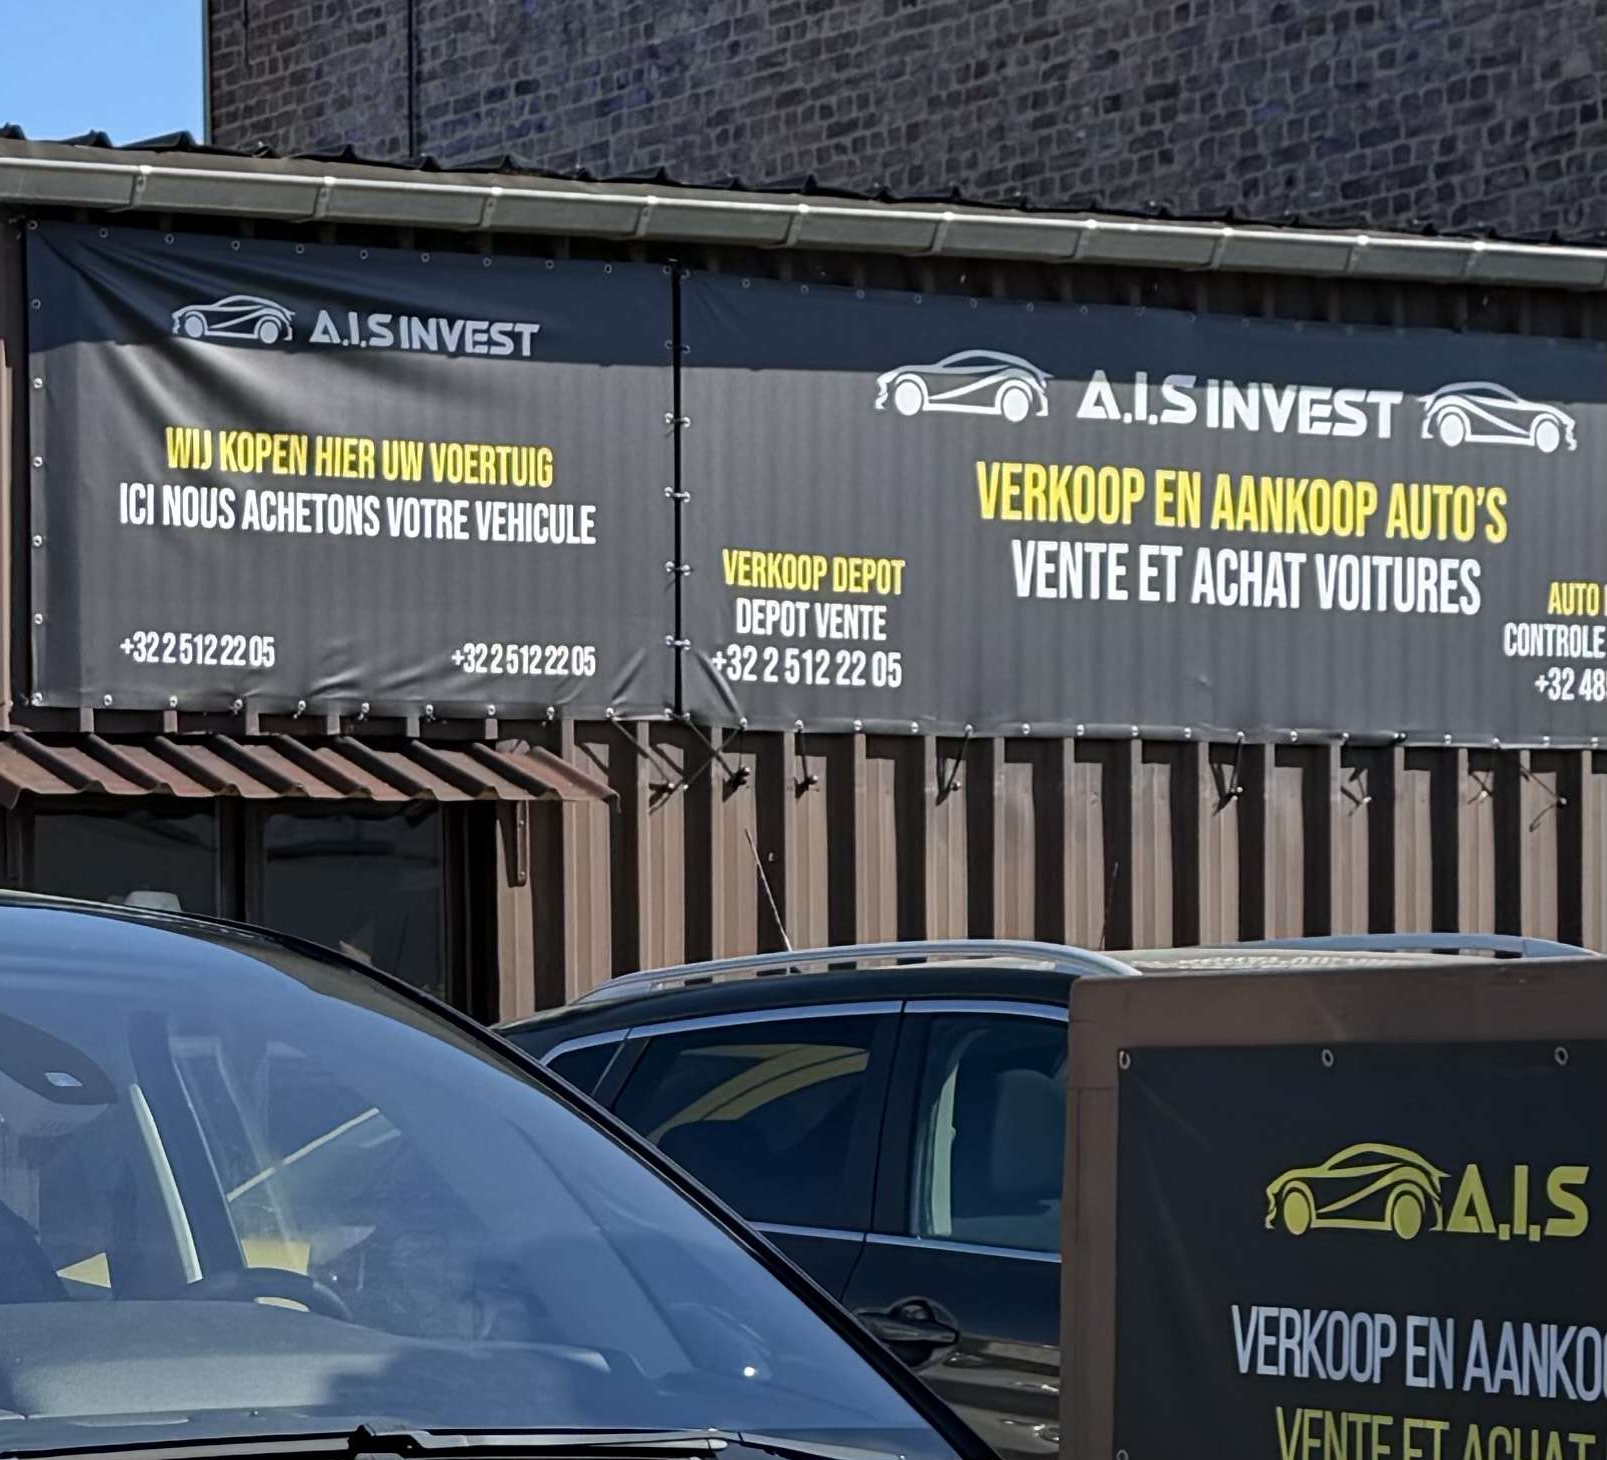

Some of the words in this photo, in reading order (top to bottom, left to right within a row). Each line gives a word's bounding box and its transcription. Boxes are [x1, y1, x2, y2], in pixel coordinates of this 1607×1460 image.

[309, 309, 393, 348] A.I.S
[400, 315, 541, 359] INVEST
[1075, 369, 1198, 426] A.I.S
[1205, 378, 1405, 440] INVEST
[165, 426, 213, 471] WIJ
[218, 430, 309, 477] KOPEN
[314, 435, 376, 480] HIER
[381, 439, 425, 483] UW
[430, 441, 554, 489] VOERTUIG
[119, 482, 155, 526] ICI
[161, 484, 236, 530] NOUS
[241, 489, 381, 537] ACHETONS
[387, 496, 470, 541] VOTRE
[475, 500, 597, 545] VEHICULE
[975, 460, 1145, 526] VERKOOP
[1154, 469, 1202, 529] EN
[1210, 473, 1379, 538] AANKOOP
[1385, 483, 1508, 545] AUTO'S
[722, 548, 828, 592] VERKOOP
[832, 556, 907, 596] DEPOT
[1011, 539, 1129, 601] VENTE
[1138, 544, 1184, 603] ET
[1190, 547, 1307, 609] ACHAT
[1314, 553, 1482, 616] VOITURES
[1547, 581, 1600, 617] AUTO
[735, 597, 811, 638] DEPOT
[814, 602, 888, 641] VENTE
[1503, 622, 1606, 658] CONTROLE
[712, 643, 757, 682] +32
[763, 646, 779, 683] 2
[784, 647, 830, 685] 512
[836, 649, 866, 686] 22
[871, 651, 902, 688] 05
[1534, 666, 1575, 701] +32
[1578, 668, 1607, 702] 48
[1446, 1164, 1590, 1242] A.I.S
[1231, 1304, 1397, 1384] VERKOOP
[1405, 1315, 1455, 1390] EN
[1462, 1319, 1607, 1402] AANKO
